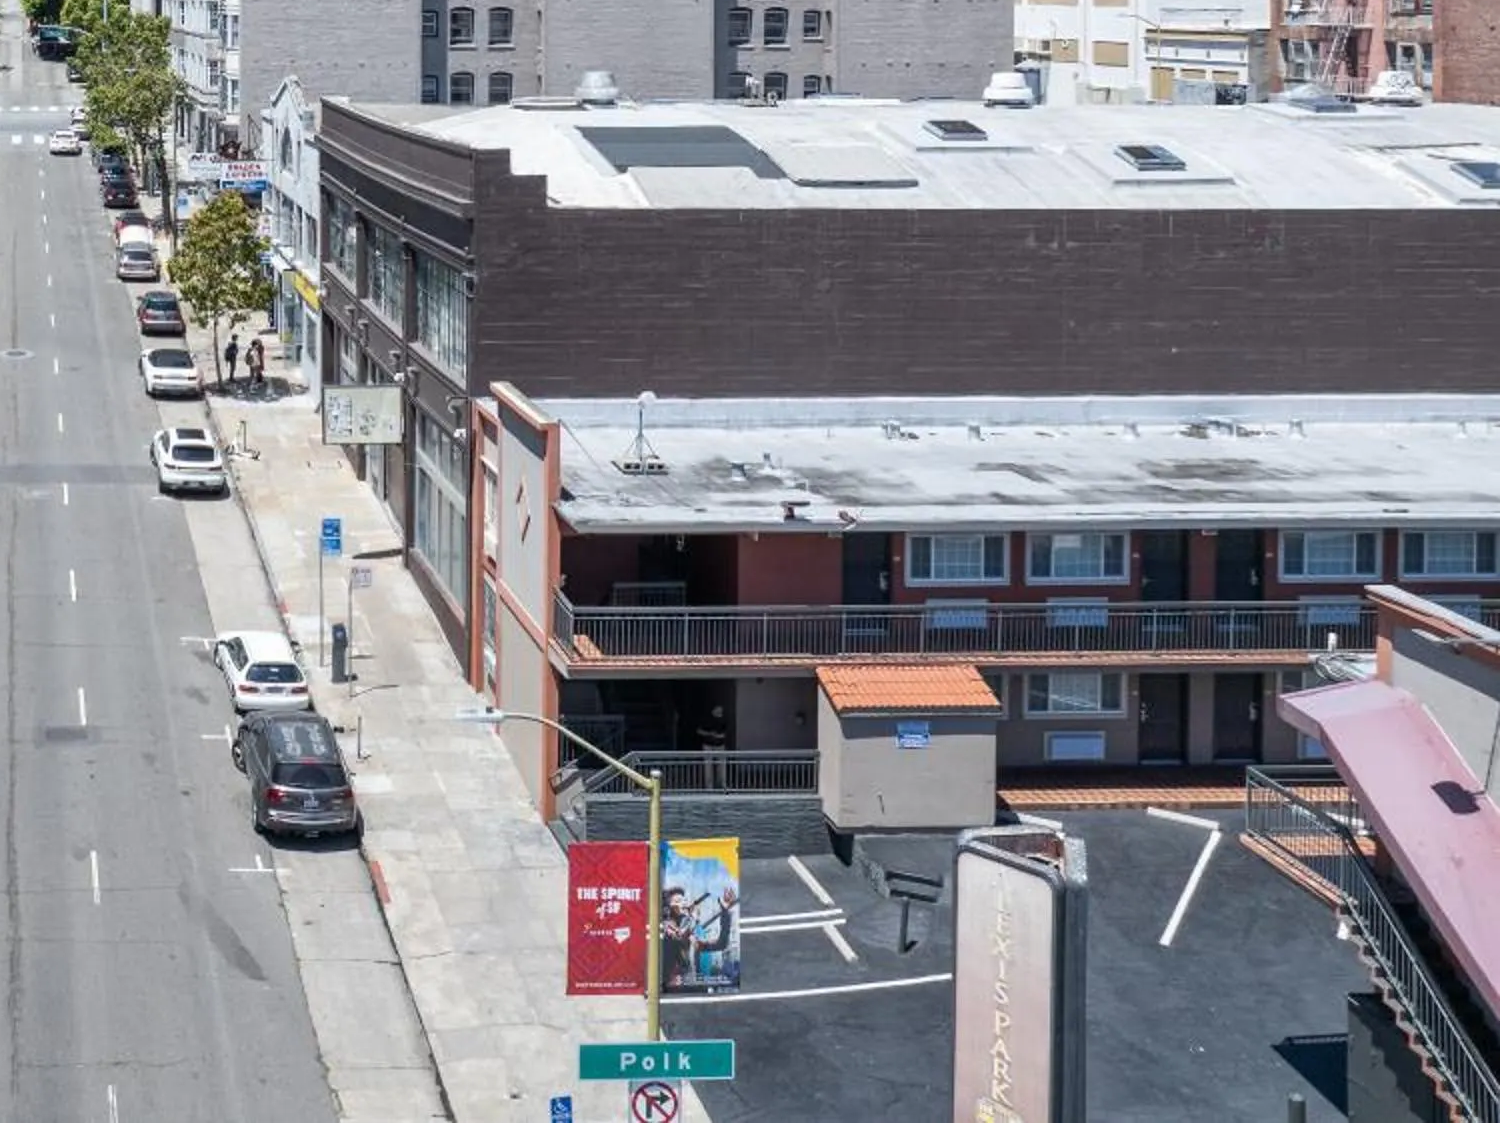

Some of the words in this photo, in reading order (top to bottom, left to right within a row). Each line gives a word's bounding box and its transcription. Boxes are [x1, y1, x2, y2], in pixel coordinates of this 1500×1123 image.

[576, 887, 599, 901] THE
[619, 1052, 692, 1071] Polk
[990, 1010, 1013, 1108] PARK
